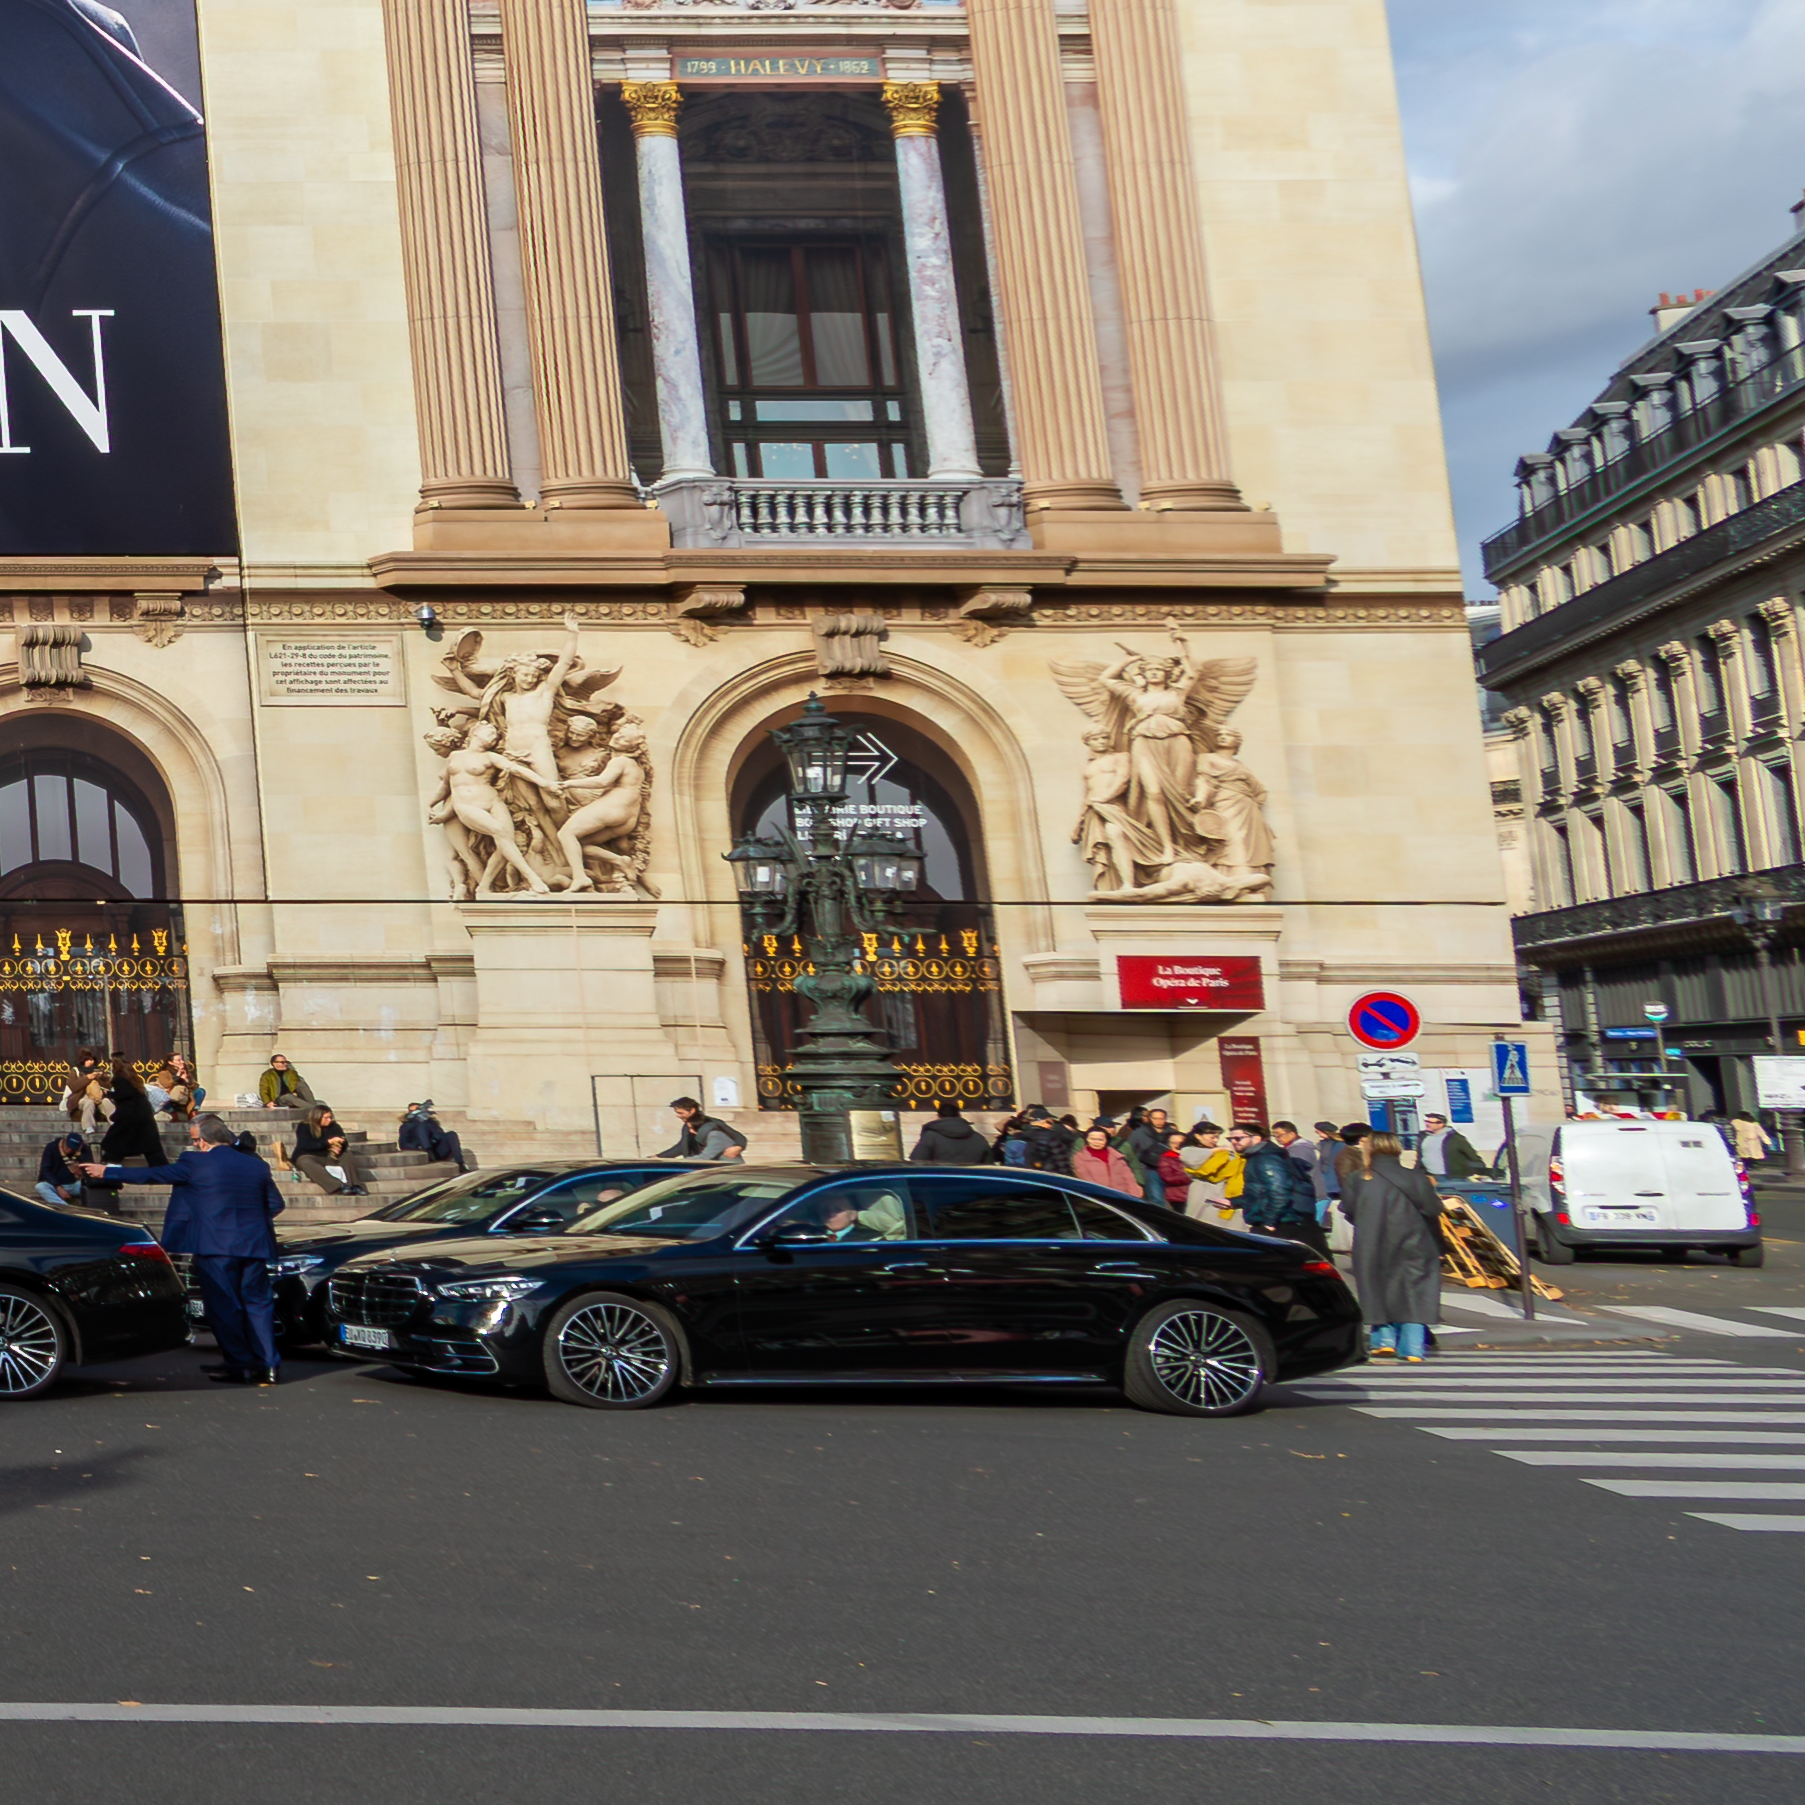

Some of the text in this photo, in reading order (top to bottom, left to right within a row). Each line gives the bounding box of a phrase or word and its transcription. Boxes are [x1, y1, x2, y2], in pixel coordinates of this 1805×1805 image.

[730, 59, 825, 75] HALEVY
[294, 644, 335, 652] application
[288, 678, 322, 686] affichage
[859, 804, 923, 815] BOUTIQUE
[863, 817, 891, 827] GIFT
[894, 817, 928, 827] SHOP
[1157, 965, 1222, 976] La Boutique
[1187, 977, 1201, 987] de
[1201, 977, 1229, 987] Paris
